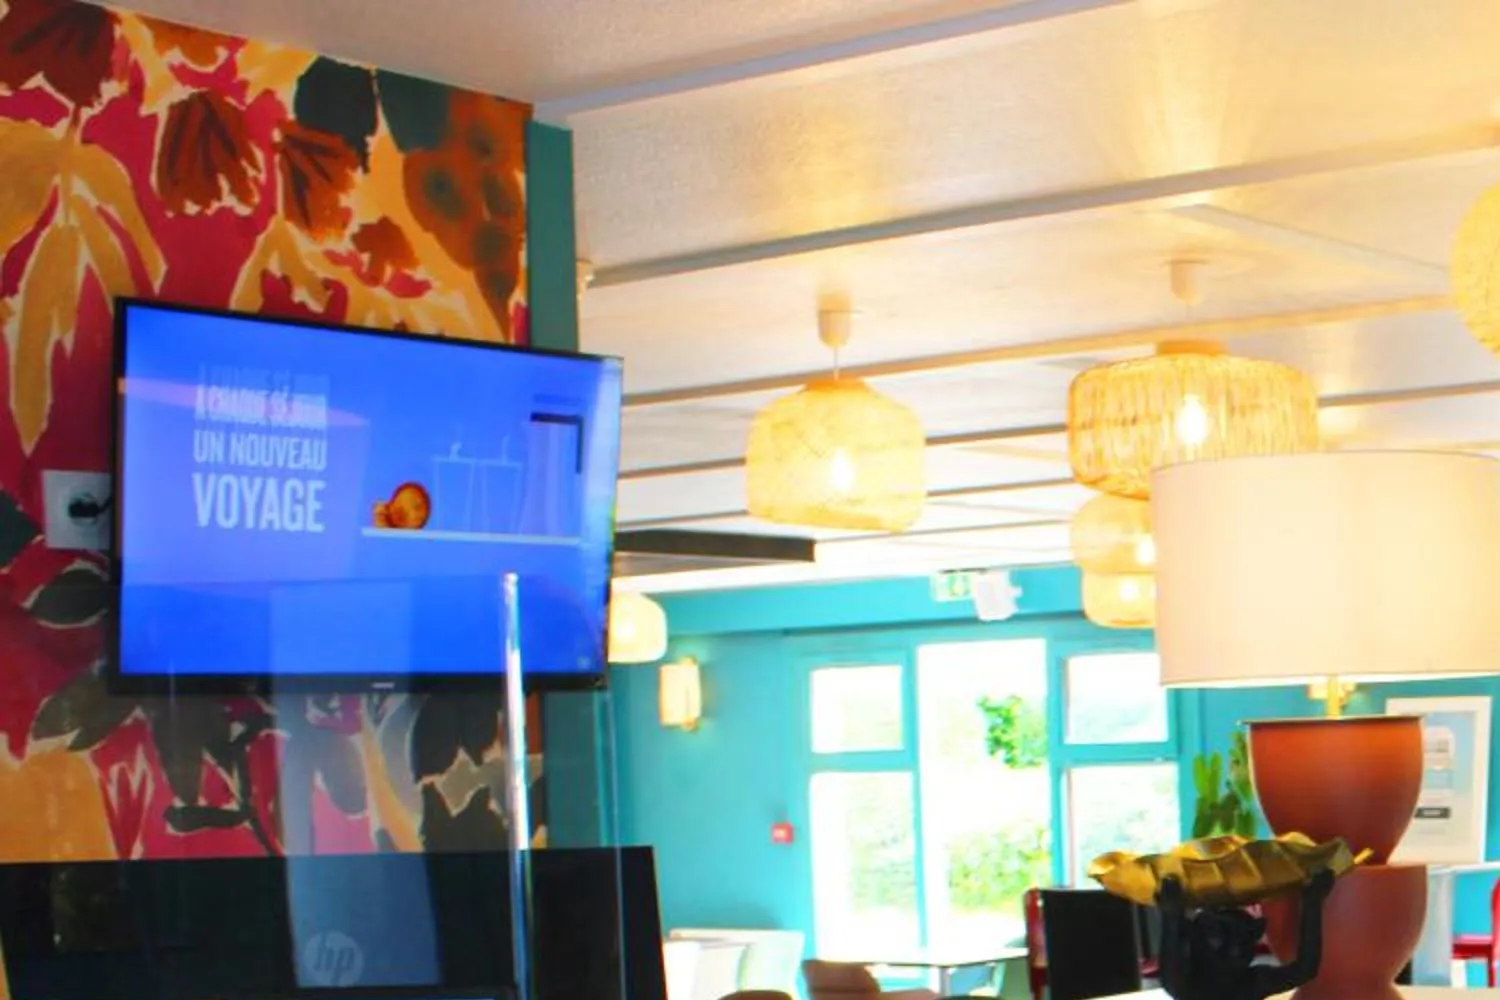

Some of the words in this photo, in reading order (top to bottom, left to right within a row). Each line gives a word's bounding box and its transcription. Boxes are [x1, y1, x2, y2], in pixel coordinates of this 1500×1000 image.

[193, 429, 225, 464] UN
[230, 431, 328, 471] NOUVEAU
[191, 471, 328, 533] VOYAGE
